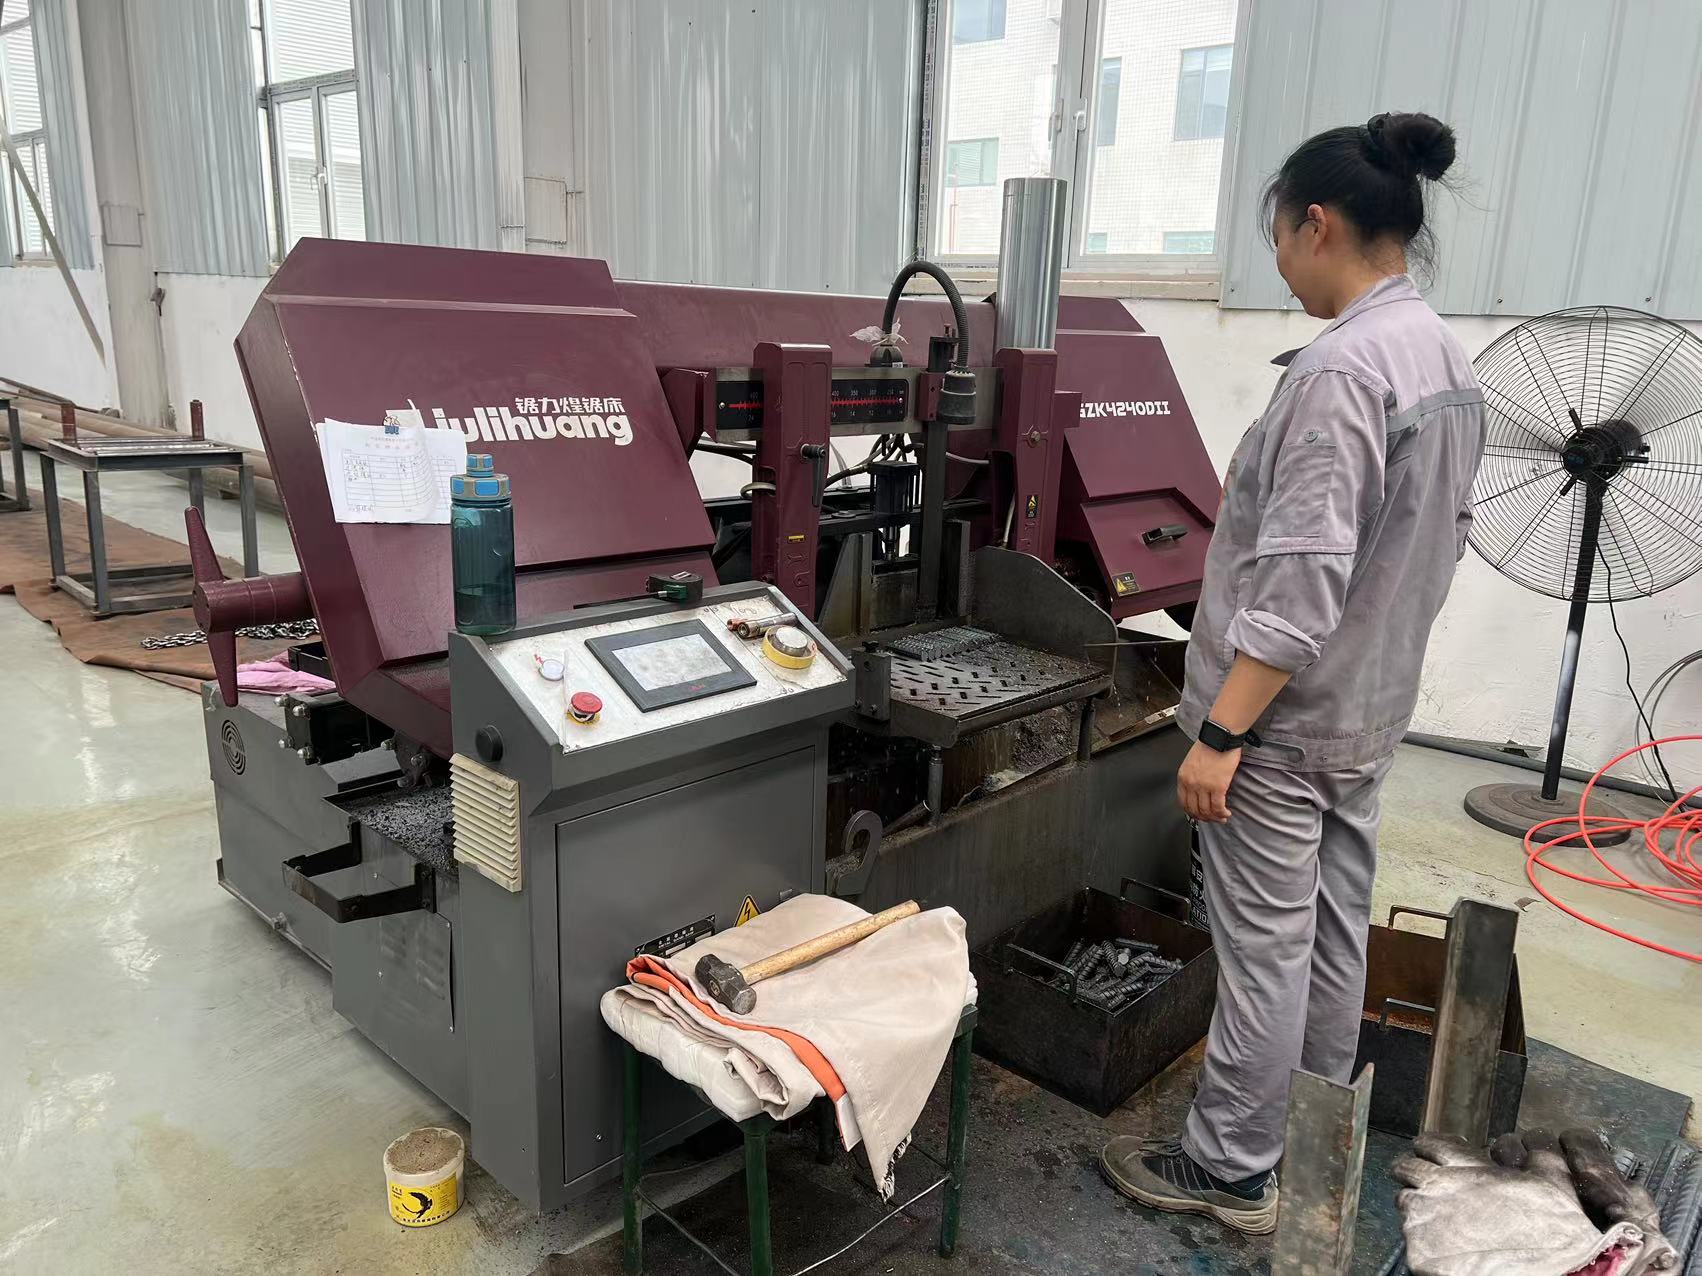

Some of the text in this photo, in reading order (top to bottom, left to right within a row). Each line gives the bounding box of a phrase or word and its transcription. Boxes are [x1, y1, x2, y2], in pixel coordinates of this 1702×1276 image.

[515, 397, 625, 414] 锯力煌锯床
